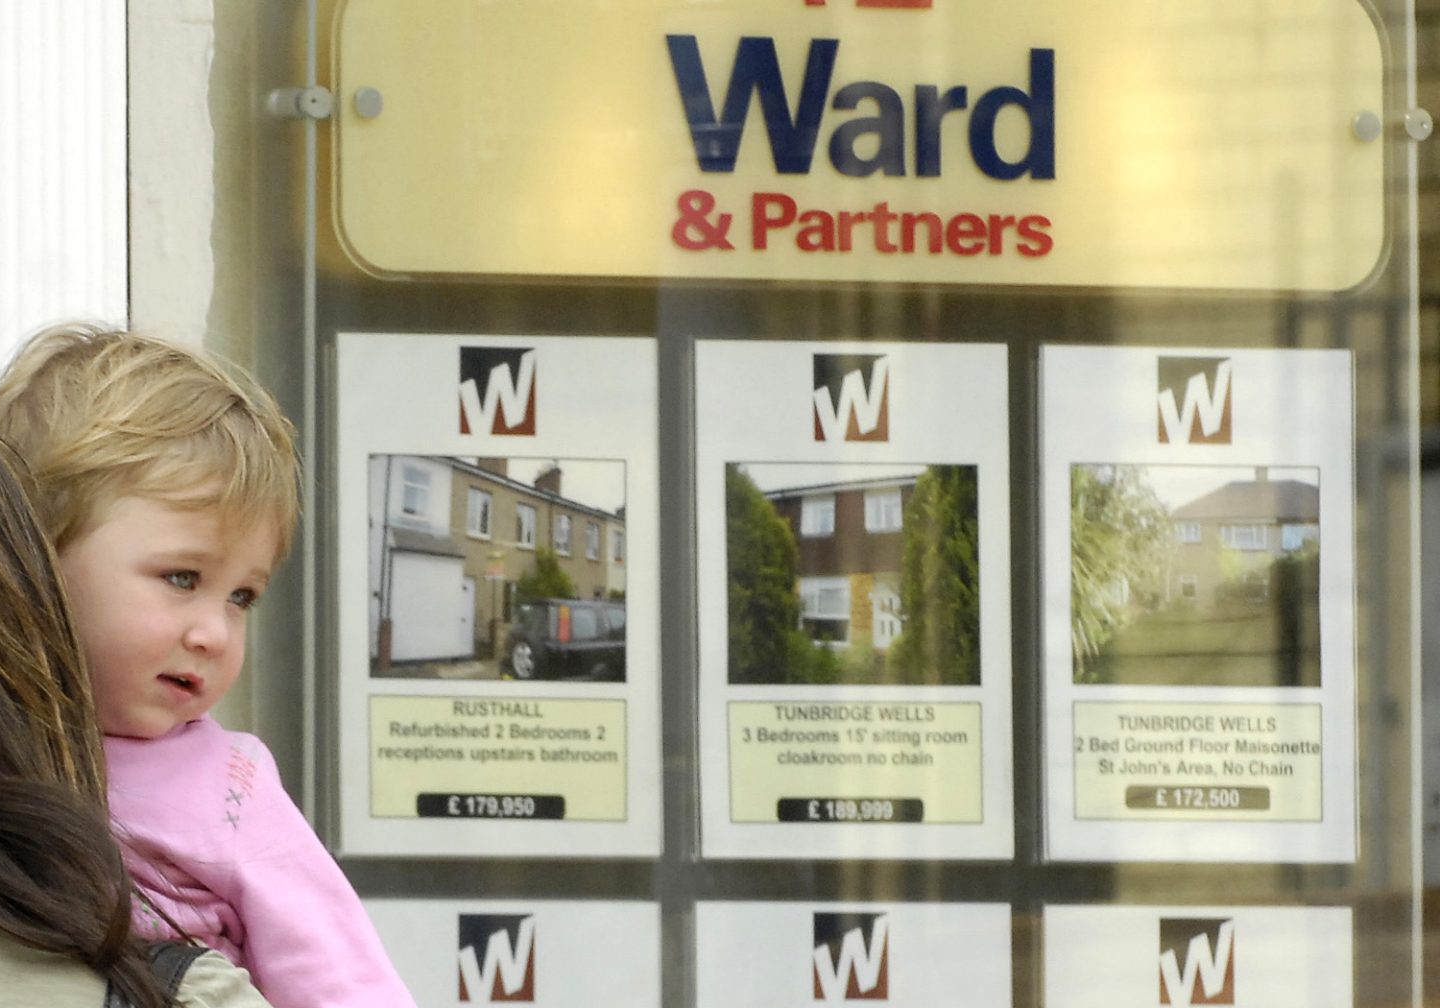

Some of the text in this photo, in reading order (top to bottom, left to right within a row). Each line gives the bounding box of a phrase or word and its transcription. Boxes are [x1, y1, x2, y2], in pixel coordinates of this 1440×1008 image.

[666, 35, 1055, 180] Ward
[671, 190, 1054, 257] & Partners
[453, 700, 543, 717] RUSTHALL
[775, 705, 934, 721] TUNBRIDGE WELLS
[390, 722, 605, 740] Refurbished 2 Bedrooms 2
[1118, 715, 1276, 732] TUNBRIDGE WELLS
[743, 728, 751, 742] 3
[757, 727, 839, 743] Bedrooms
[873, 729, 919, 746] sitting
[926, 732, 968, 743] room
[378, 746, 618, 762] receptions upstairs bathroom
[1075, 737, 1320, 754] 2 Bed Ground Floor Maisonette
[777, 750, 933, 765] cloakroom no chain
[1099, 758, 1293, 776] St John's Area, No Chain
[448, 796, 534, 815] £ 179,950
[1156, 790, 1239, 808] £ 172,500
[808, 802, 820, 818] £
